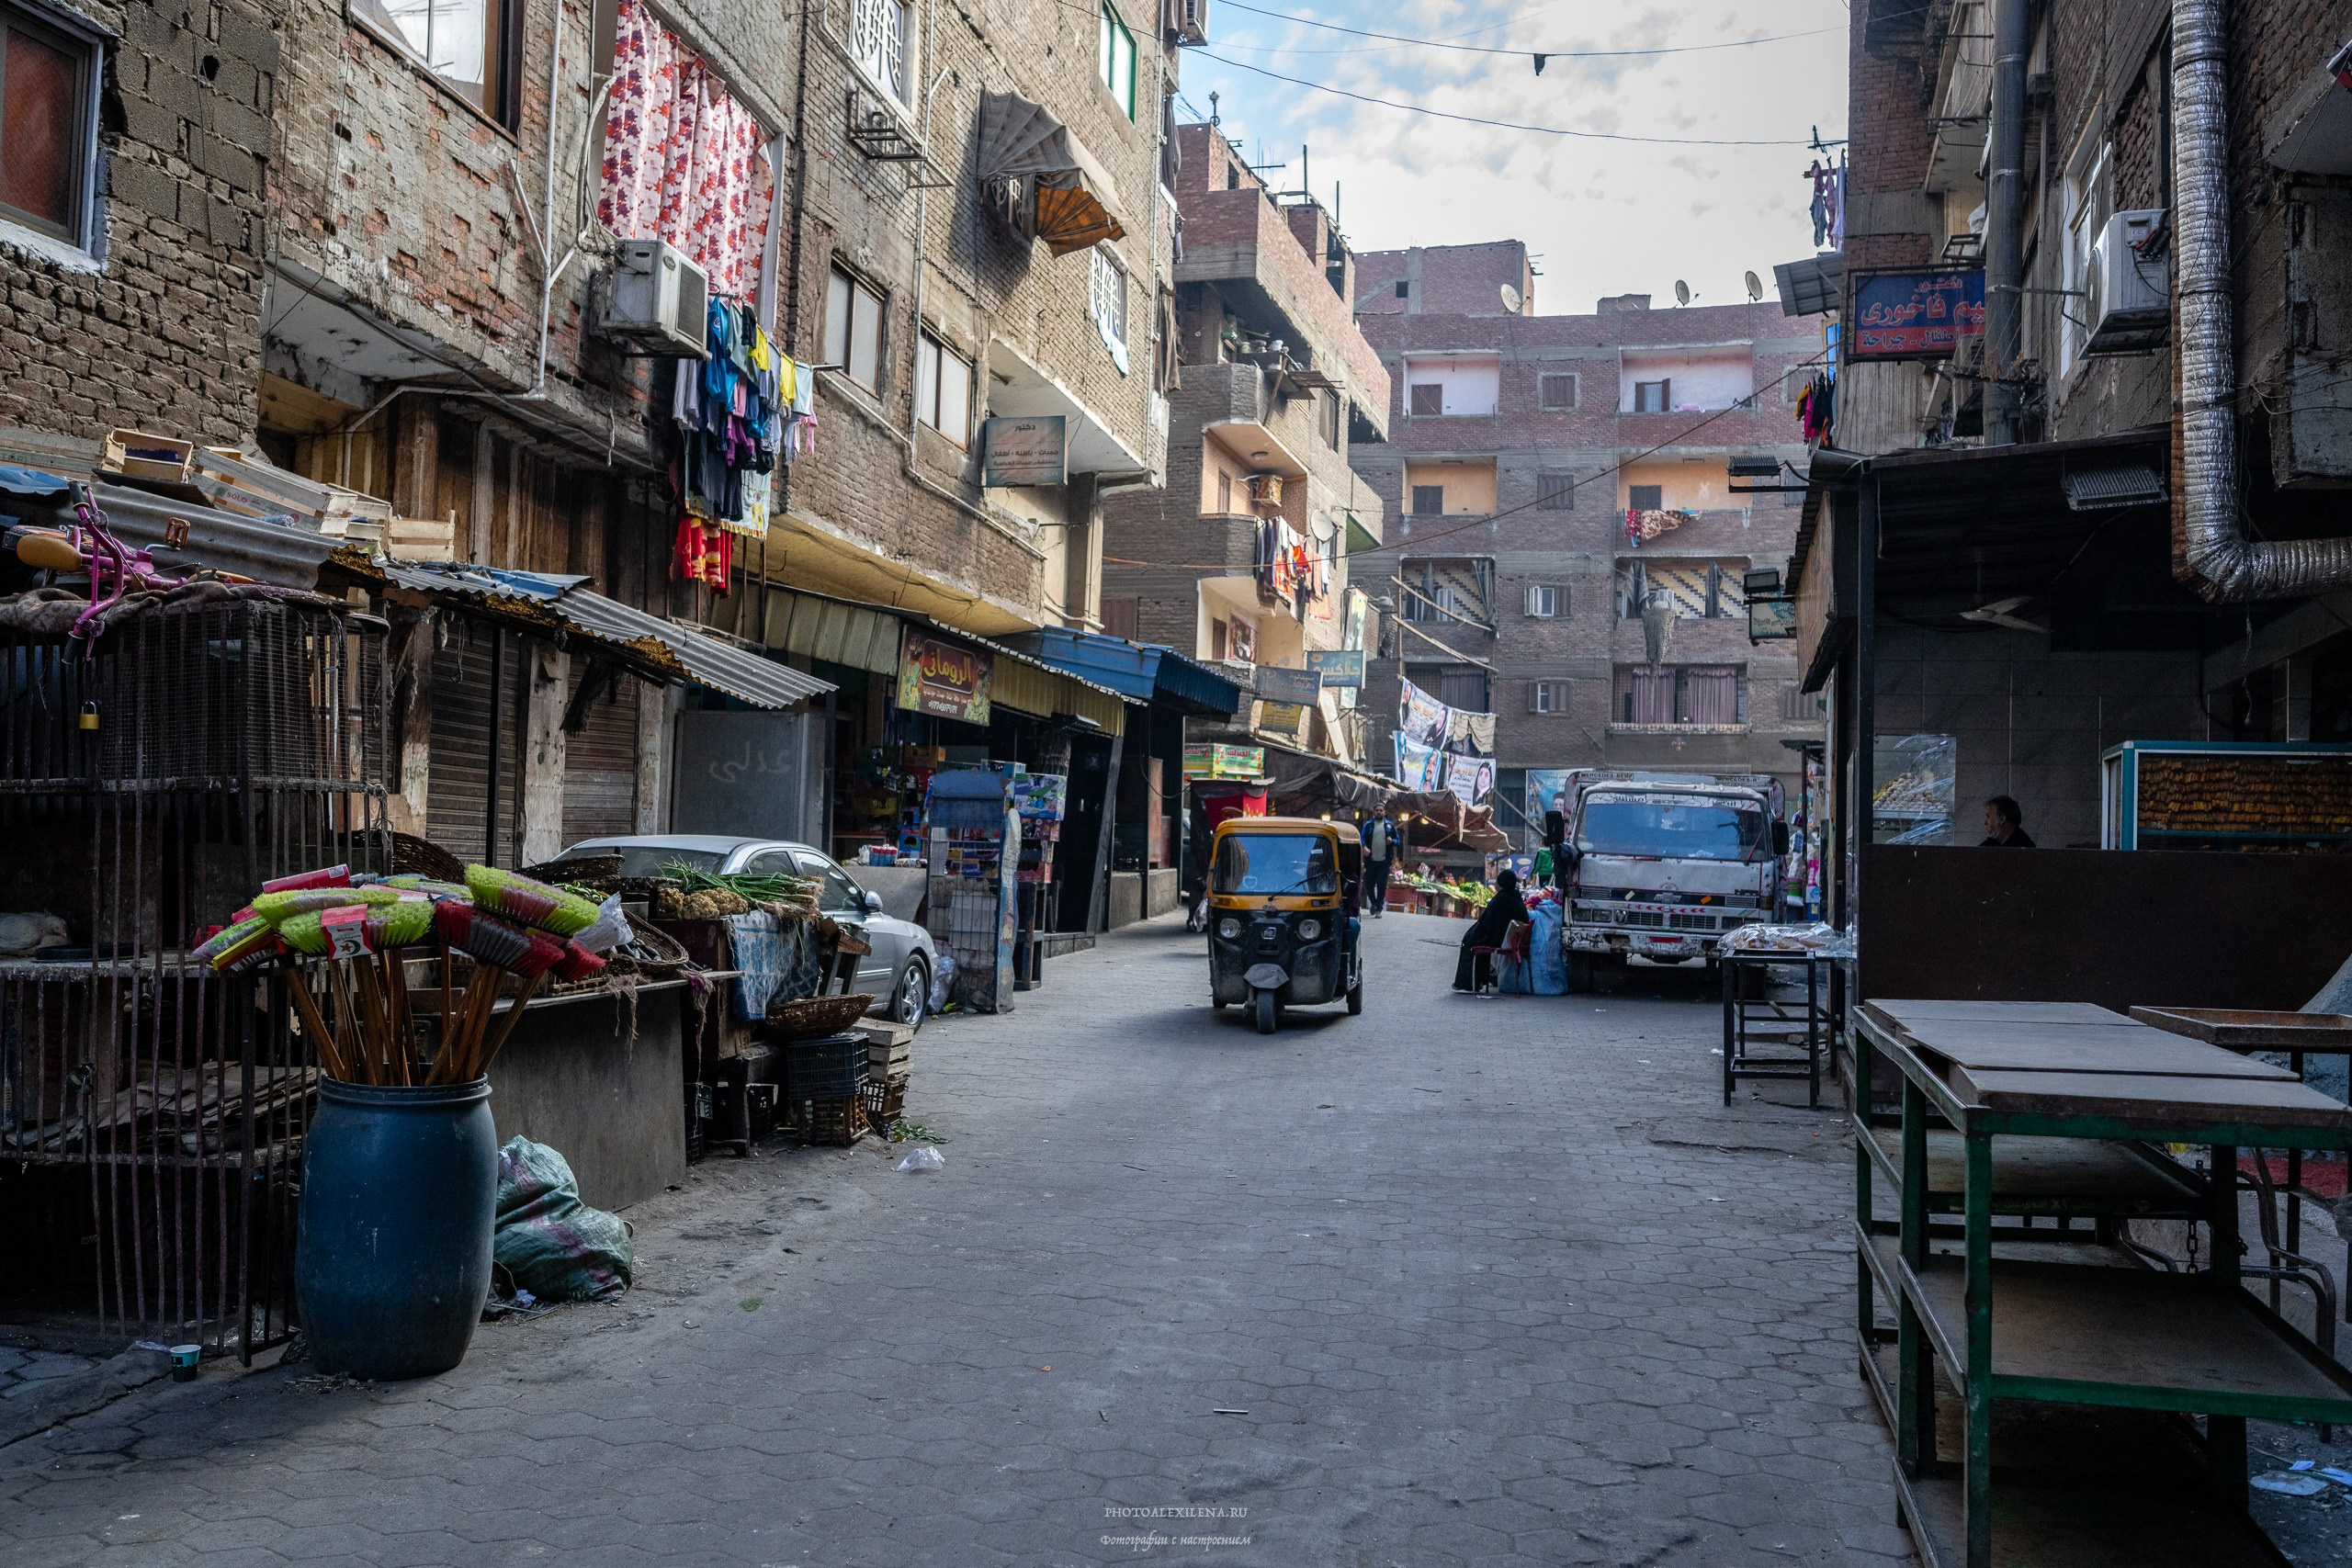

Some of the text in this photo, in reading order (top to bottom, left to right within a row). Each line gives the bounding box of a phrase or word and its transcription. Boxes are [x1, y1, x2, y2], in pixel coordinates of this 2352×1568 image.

[1916, 276, 1963, 293] دكتور
[1862, 332, 1906, 349] جراحة
[1014, 423, 1036, 433] دكتور
[226, 491, 247, 502] SOLO
